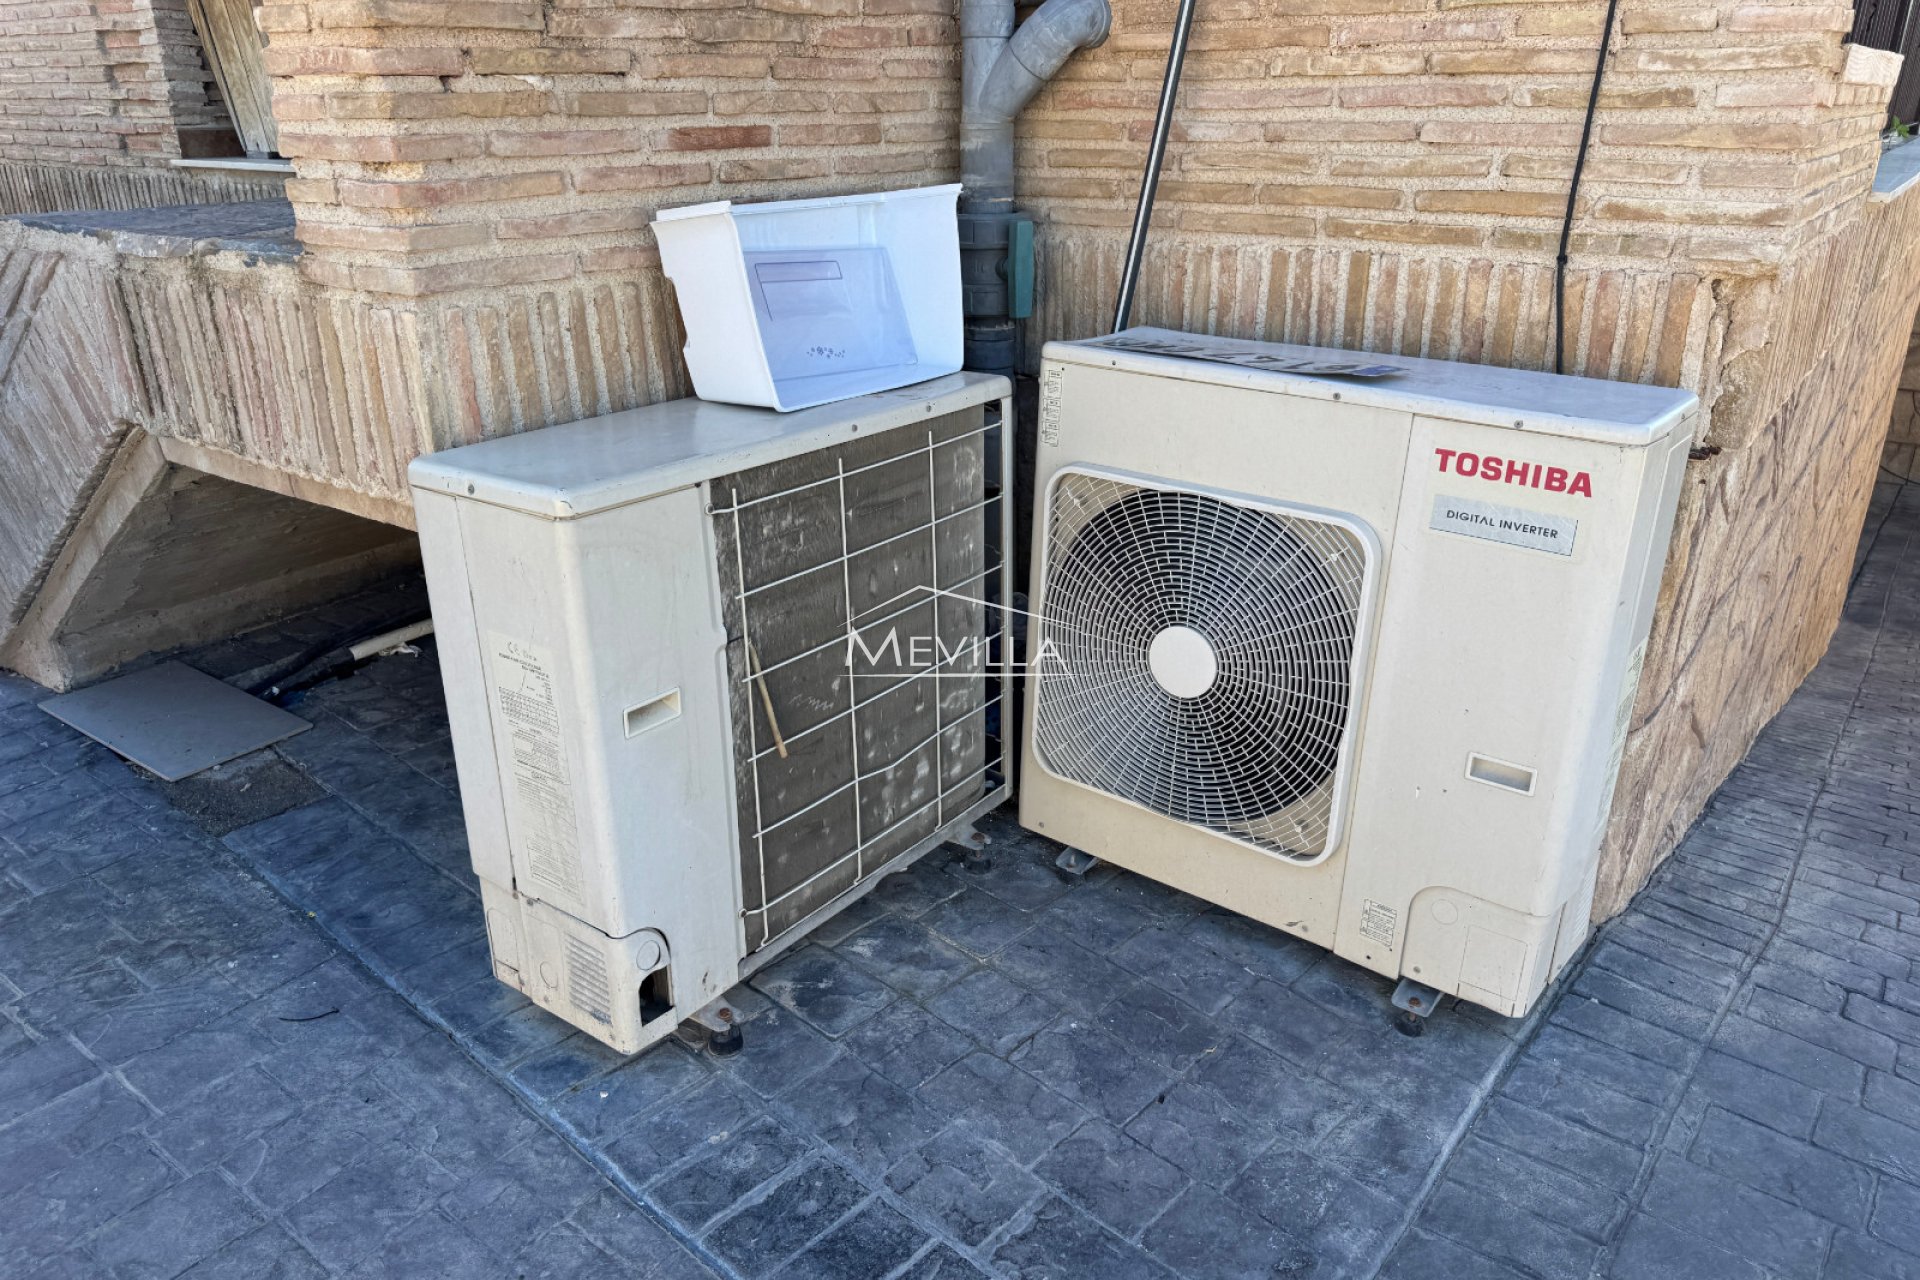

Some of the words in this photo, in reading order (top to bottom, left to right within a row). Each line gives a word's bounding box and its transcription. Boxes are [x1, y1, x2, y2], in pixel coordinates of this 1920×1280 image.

[1435, 448, 1592, 497] TOSHIBA
[1446, 510, 1495, 527] DIGITAL
[1499, 519, 1559, 539] INVERTER
